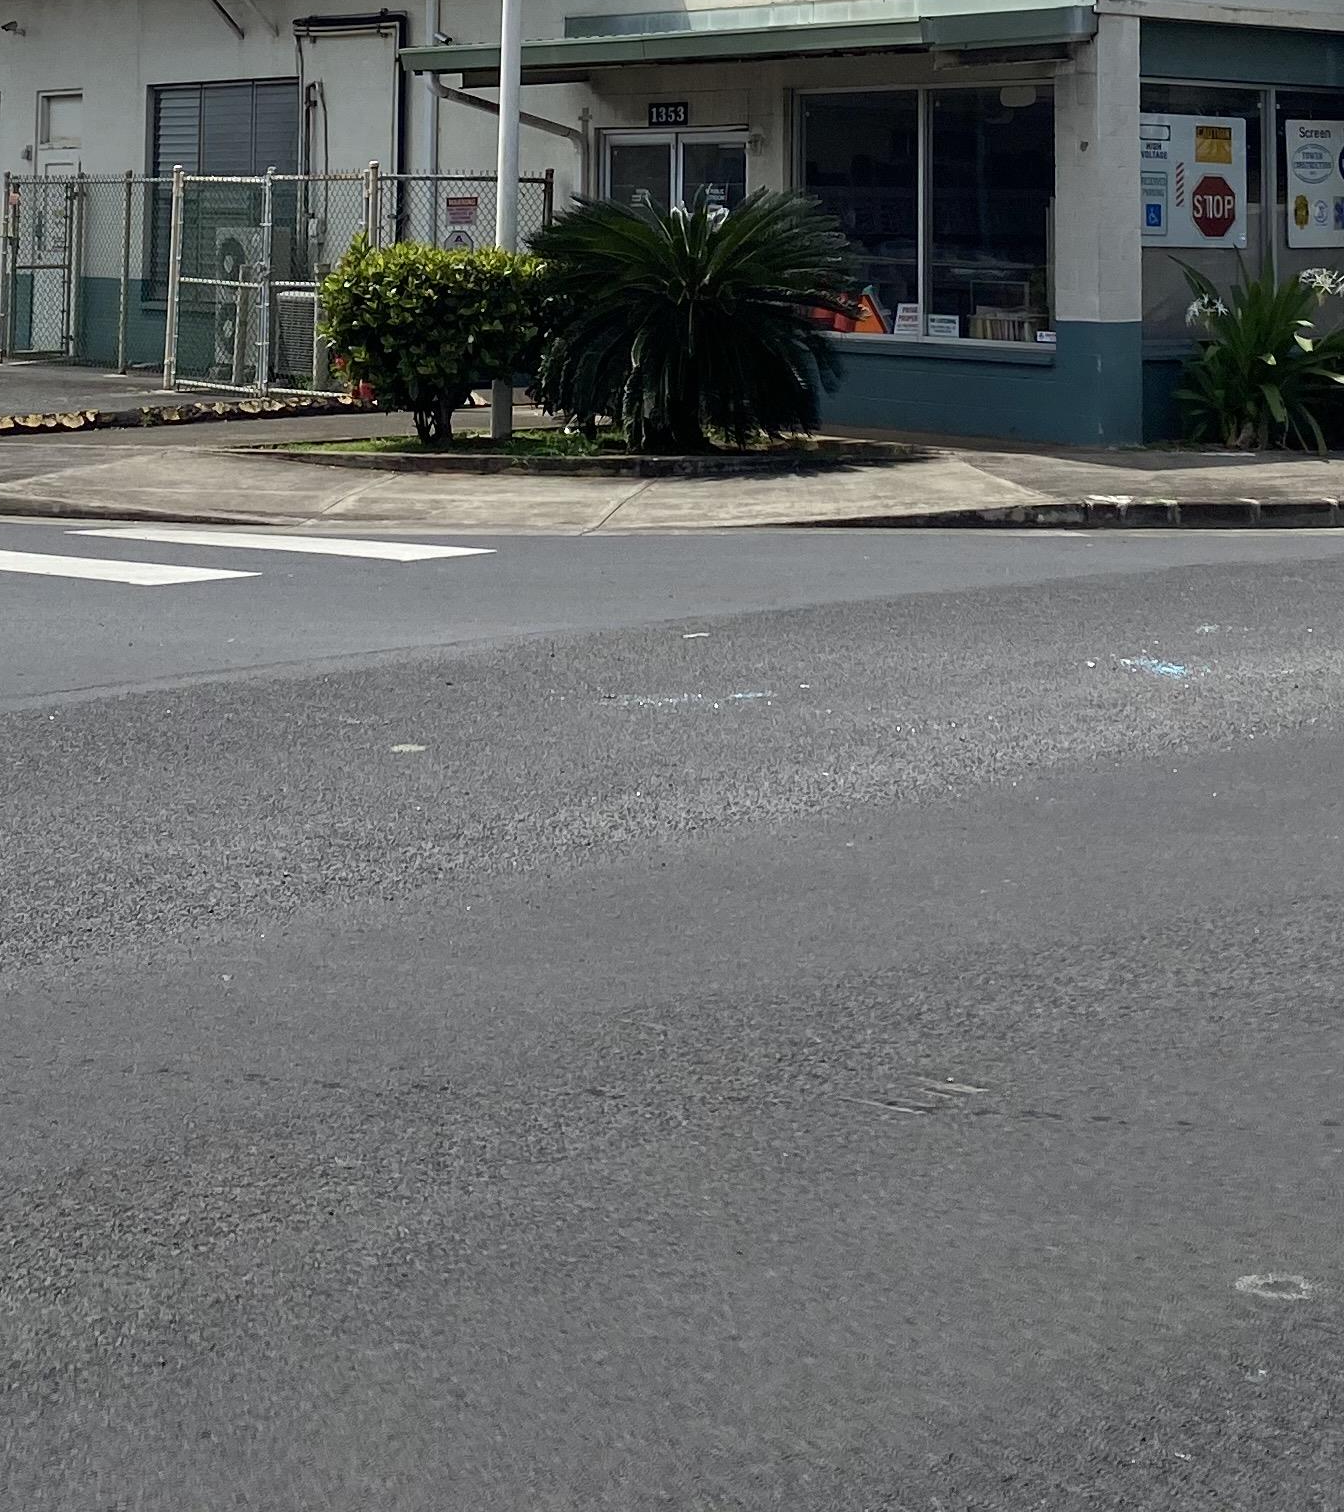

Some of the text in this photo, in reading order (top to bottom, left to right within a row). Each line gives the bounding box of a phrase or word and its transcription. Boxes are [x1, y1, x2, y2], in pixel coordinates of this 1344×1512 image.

[650, 106, 685, 123] 1353
[1299, 126, 1332, 139] Screen
[1193, 194, 1234, 219] STOP
